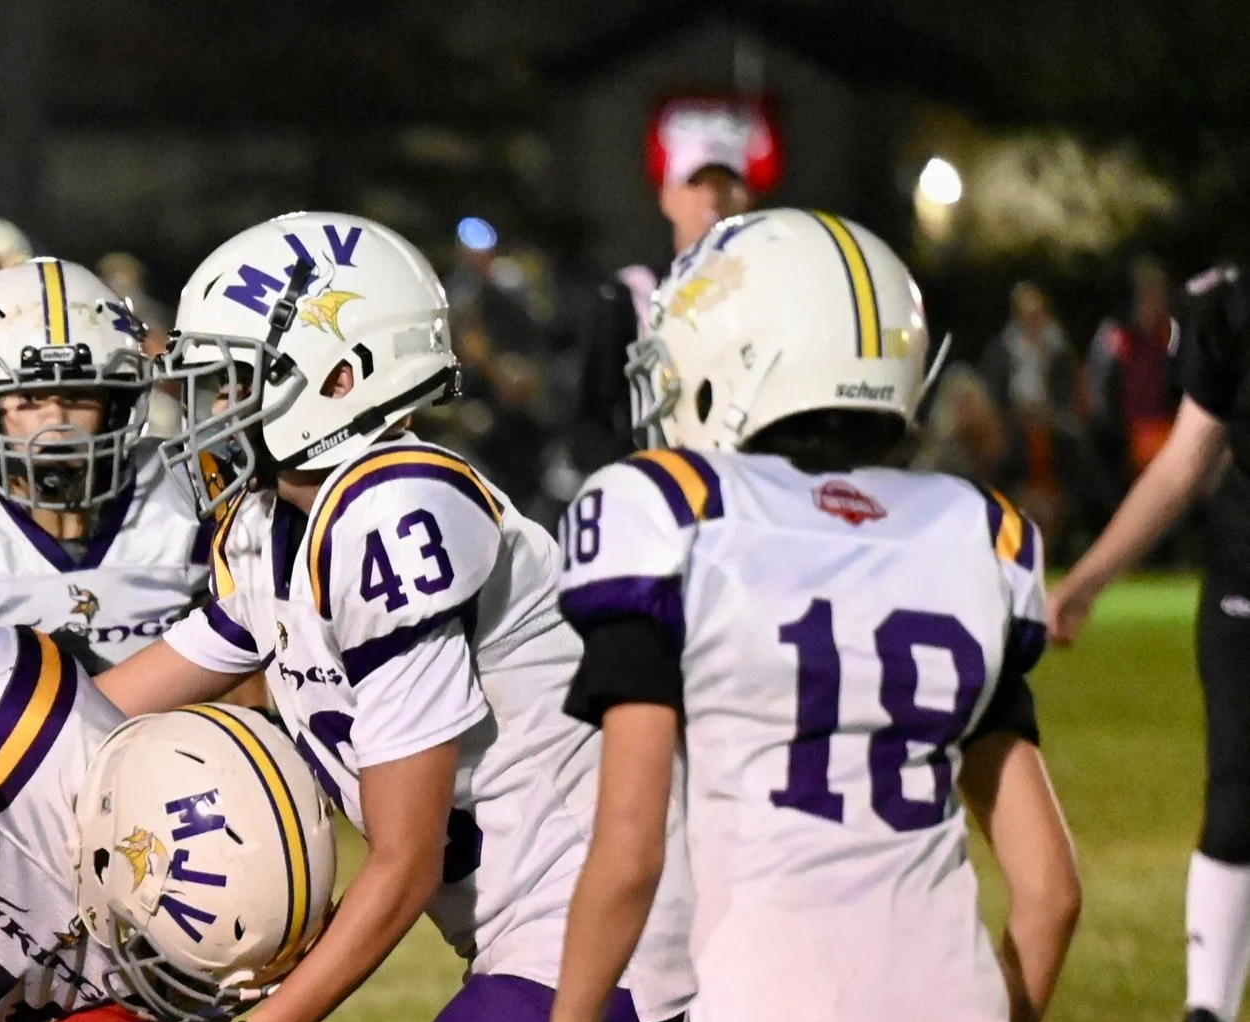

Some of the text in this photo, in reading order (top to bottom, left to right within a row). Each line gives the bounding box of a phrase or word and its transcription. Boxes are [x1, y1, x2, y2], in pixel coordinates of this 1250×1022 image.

[307, 428, 349, 459] schutt
[359, 508, 455, 613] 43
[769, 597, 986, 832] 18
[159, 788, 227, 943] MJV
